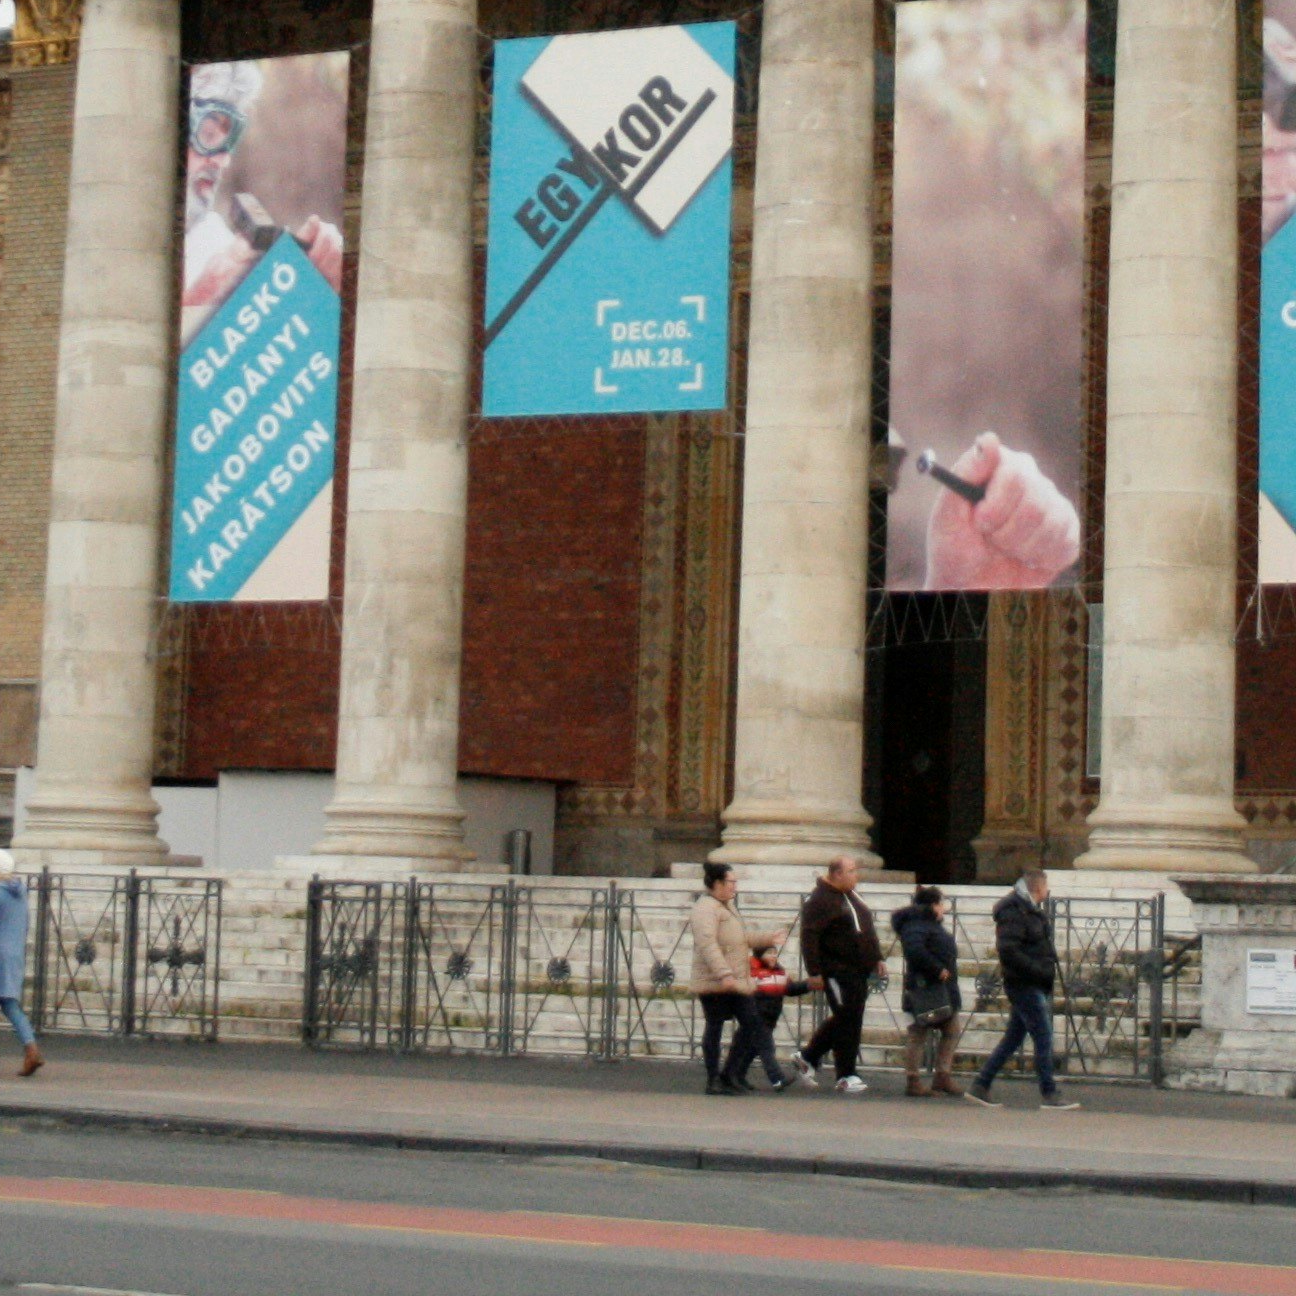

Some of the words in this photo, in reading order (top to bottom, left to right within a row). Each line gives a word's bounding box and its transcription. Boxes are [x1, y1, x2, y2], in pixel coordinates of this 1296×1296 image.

[190, 261, 297, 388] BLASKÓ
[190, 313, 310, 453] GADÁNYI
[610, 347, 692, 369] JAN.28.
[611, 320, 693, 342] DEC.06.
[181, 351, 333, 534] JAKOBOVITS
[187, 419, 330, 591] KARÁTSON
